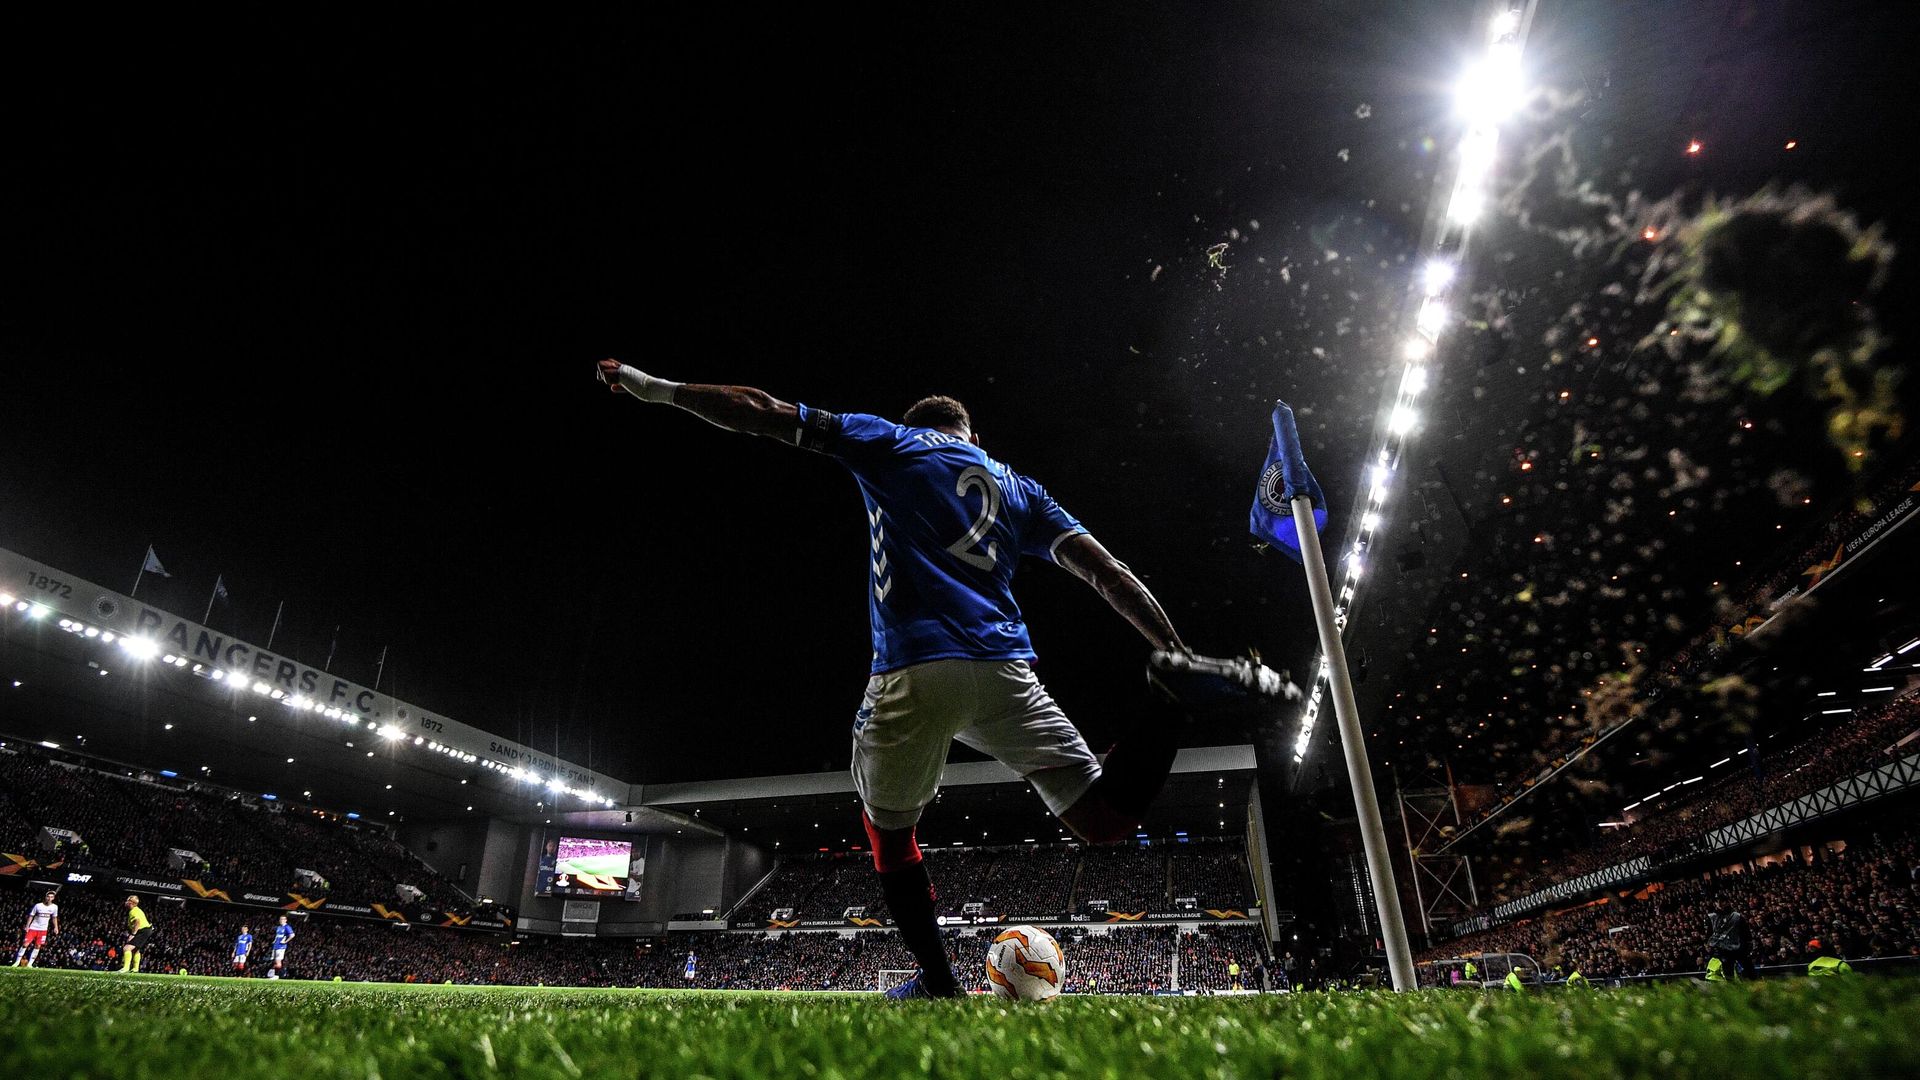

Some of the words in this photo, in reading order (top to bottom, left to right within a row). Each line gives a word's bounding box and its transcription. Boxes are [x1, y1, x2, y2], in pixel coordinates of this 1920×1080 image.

[945, 465, 1001, 572] 2
[1846, 536, 1864, 552] UEFA
[1861, 518, 1887, 541] EUROPA
[1885, 496, 1914, 522] LEAGUE
[27, 571, 73, 600] 1872
[134, 607, 320, 694] RANGERS
[331, 678, 381, 717] F.C.
[420, 716, 443, 734] 1872
[489, 741, 525, 760] SANDY
[567, 769, 595, 787] STAND
[134, 878, 158, 888] EUROPA
[158, 881, 183, 891] LEAGUE
